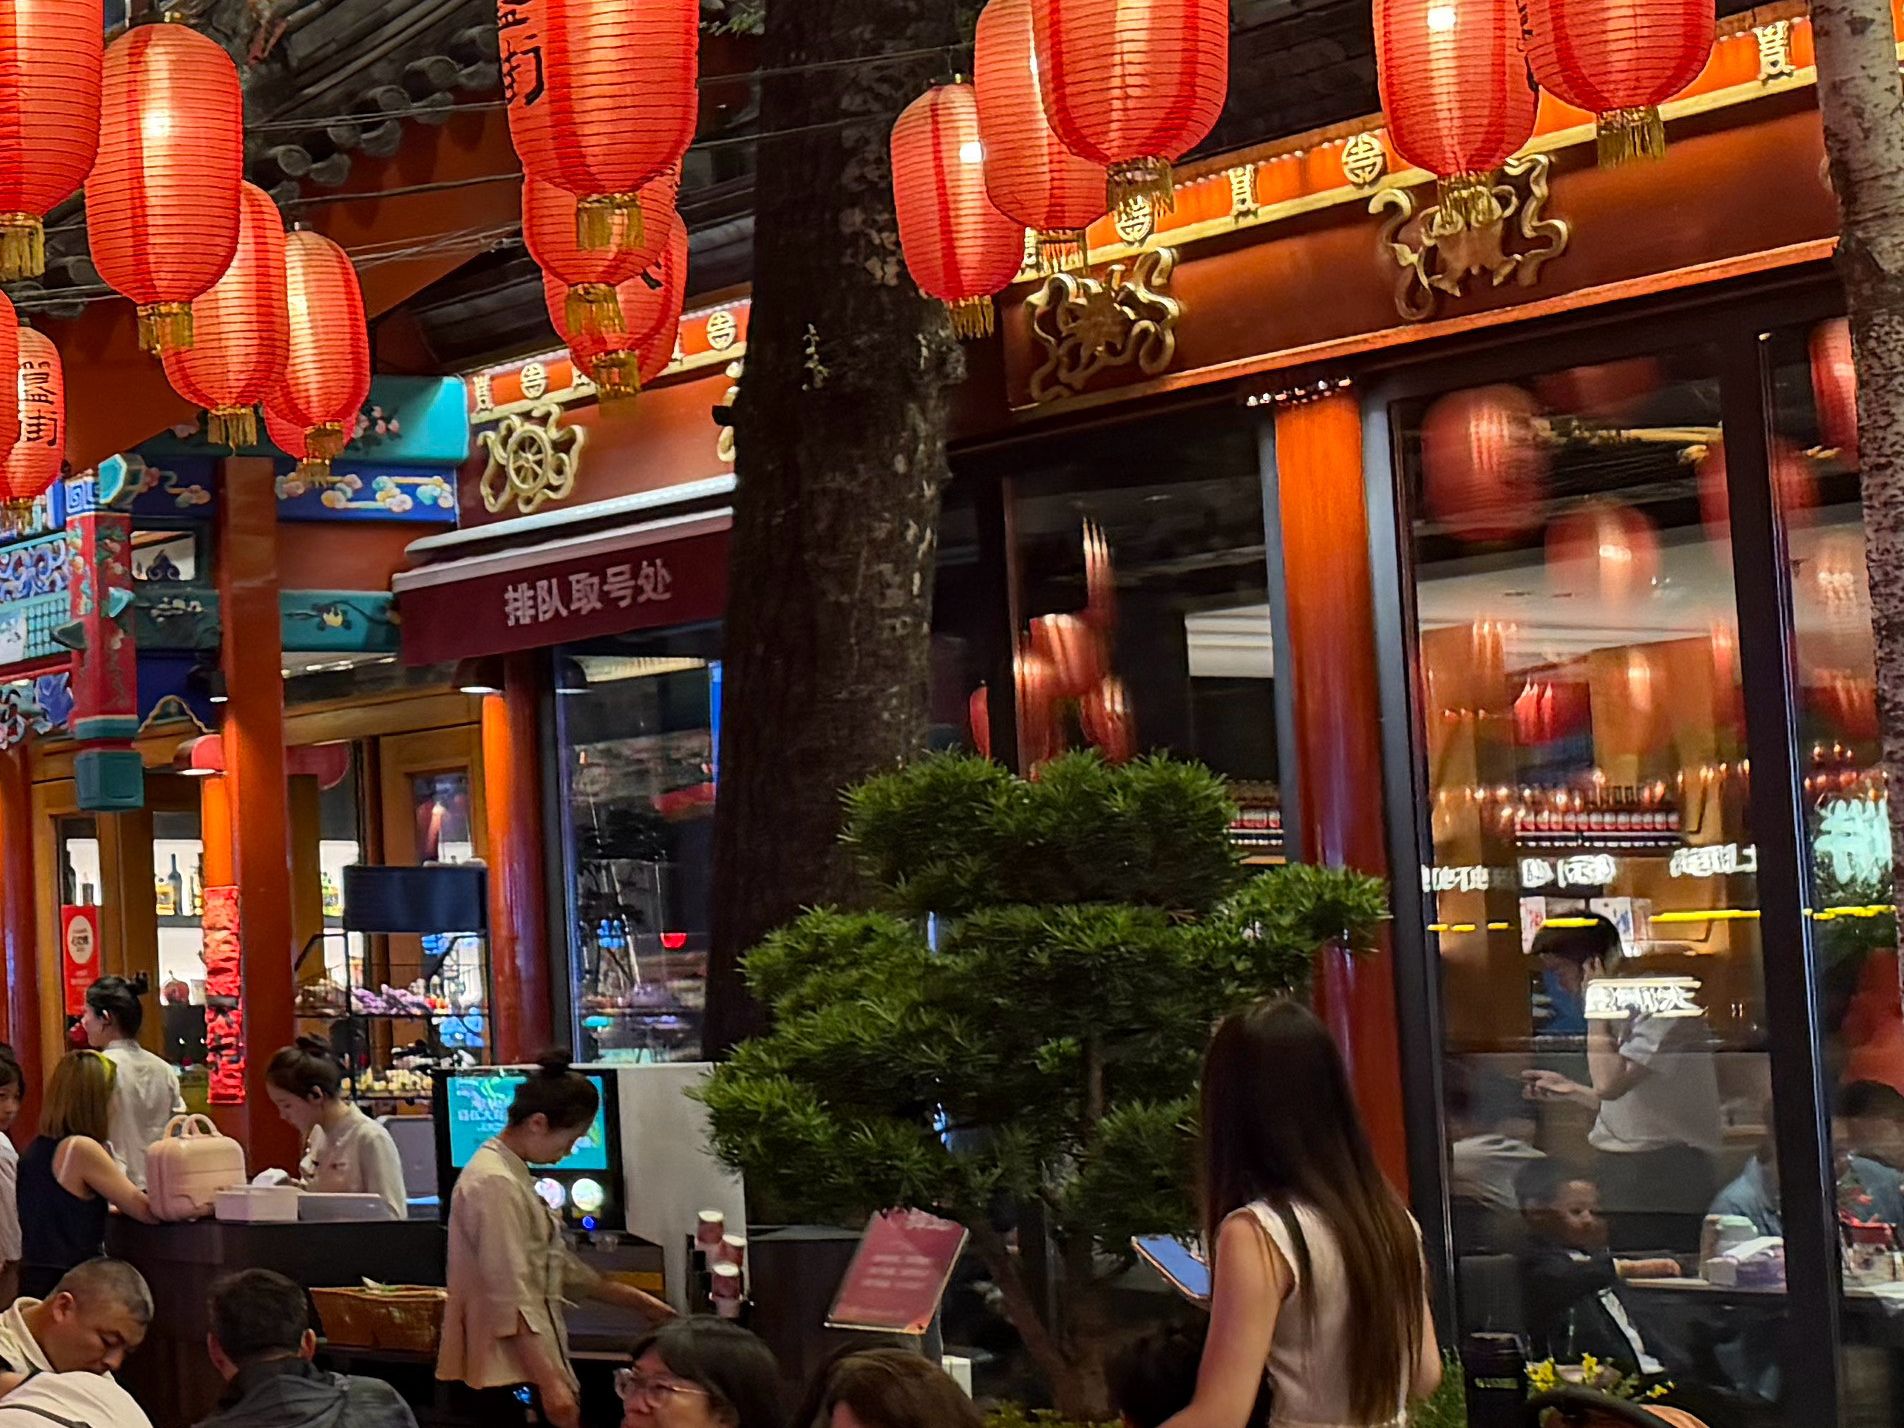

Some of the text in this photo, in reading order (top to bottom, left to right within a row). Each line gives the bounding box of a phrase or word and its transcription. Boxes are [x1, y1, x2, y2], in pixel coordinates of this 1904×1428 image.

[503, 559, 672, 626] 排队取号处
